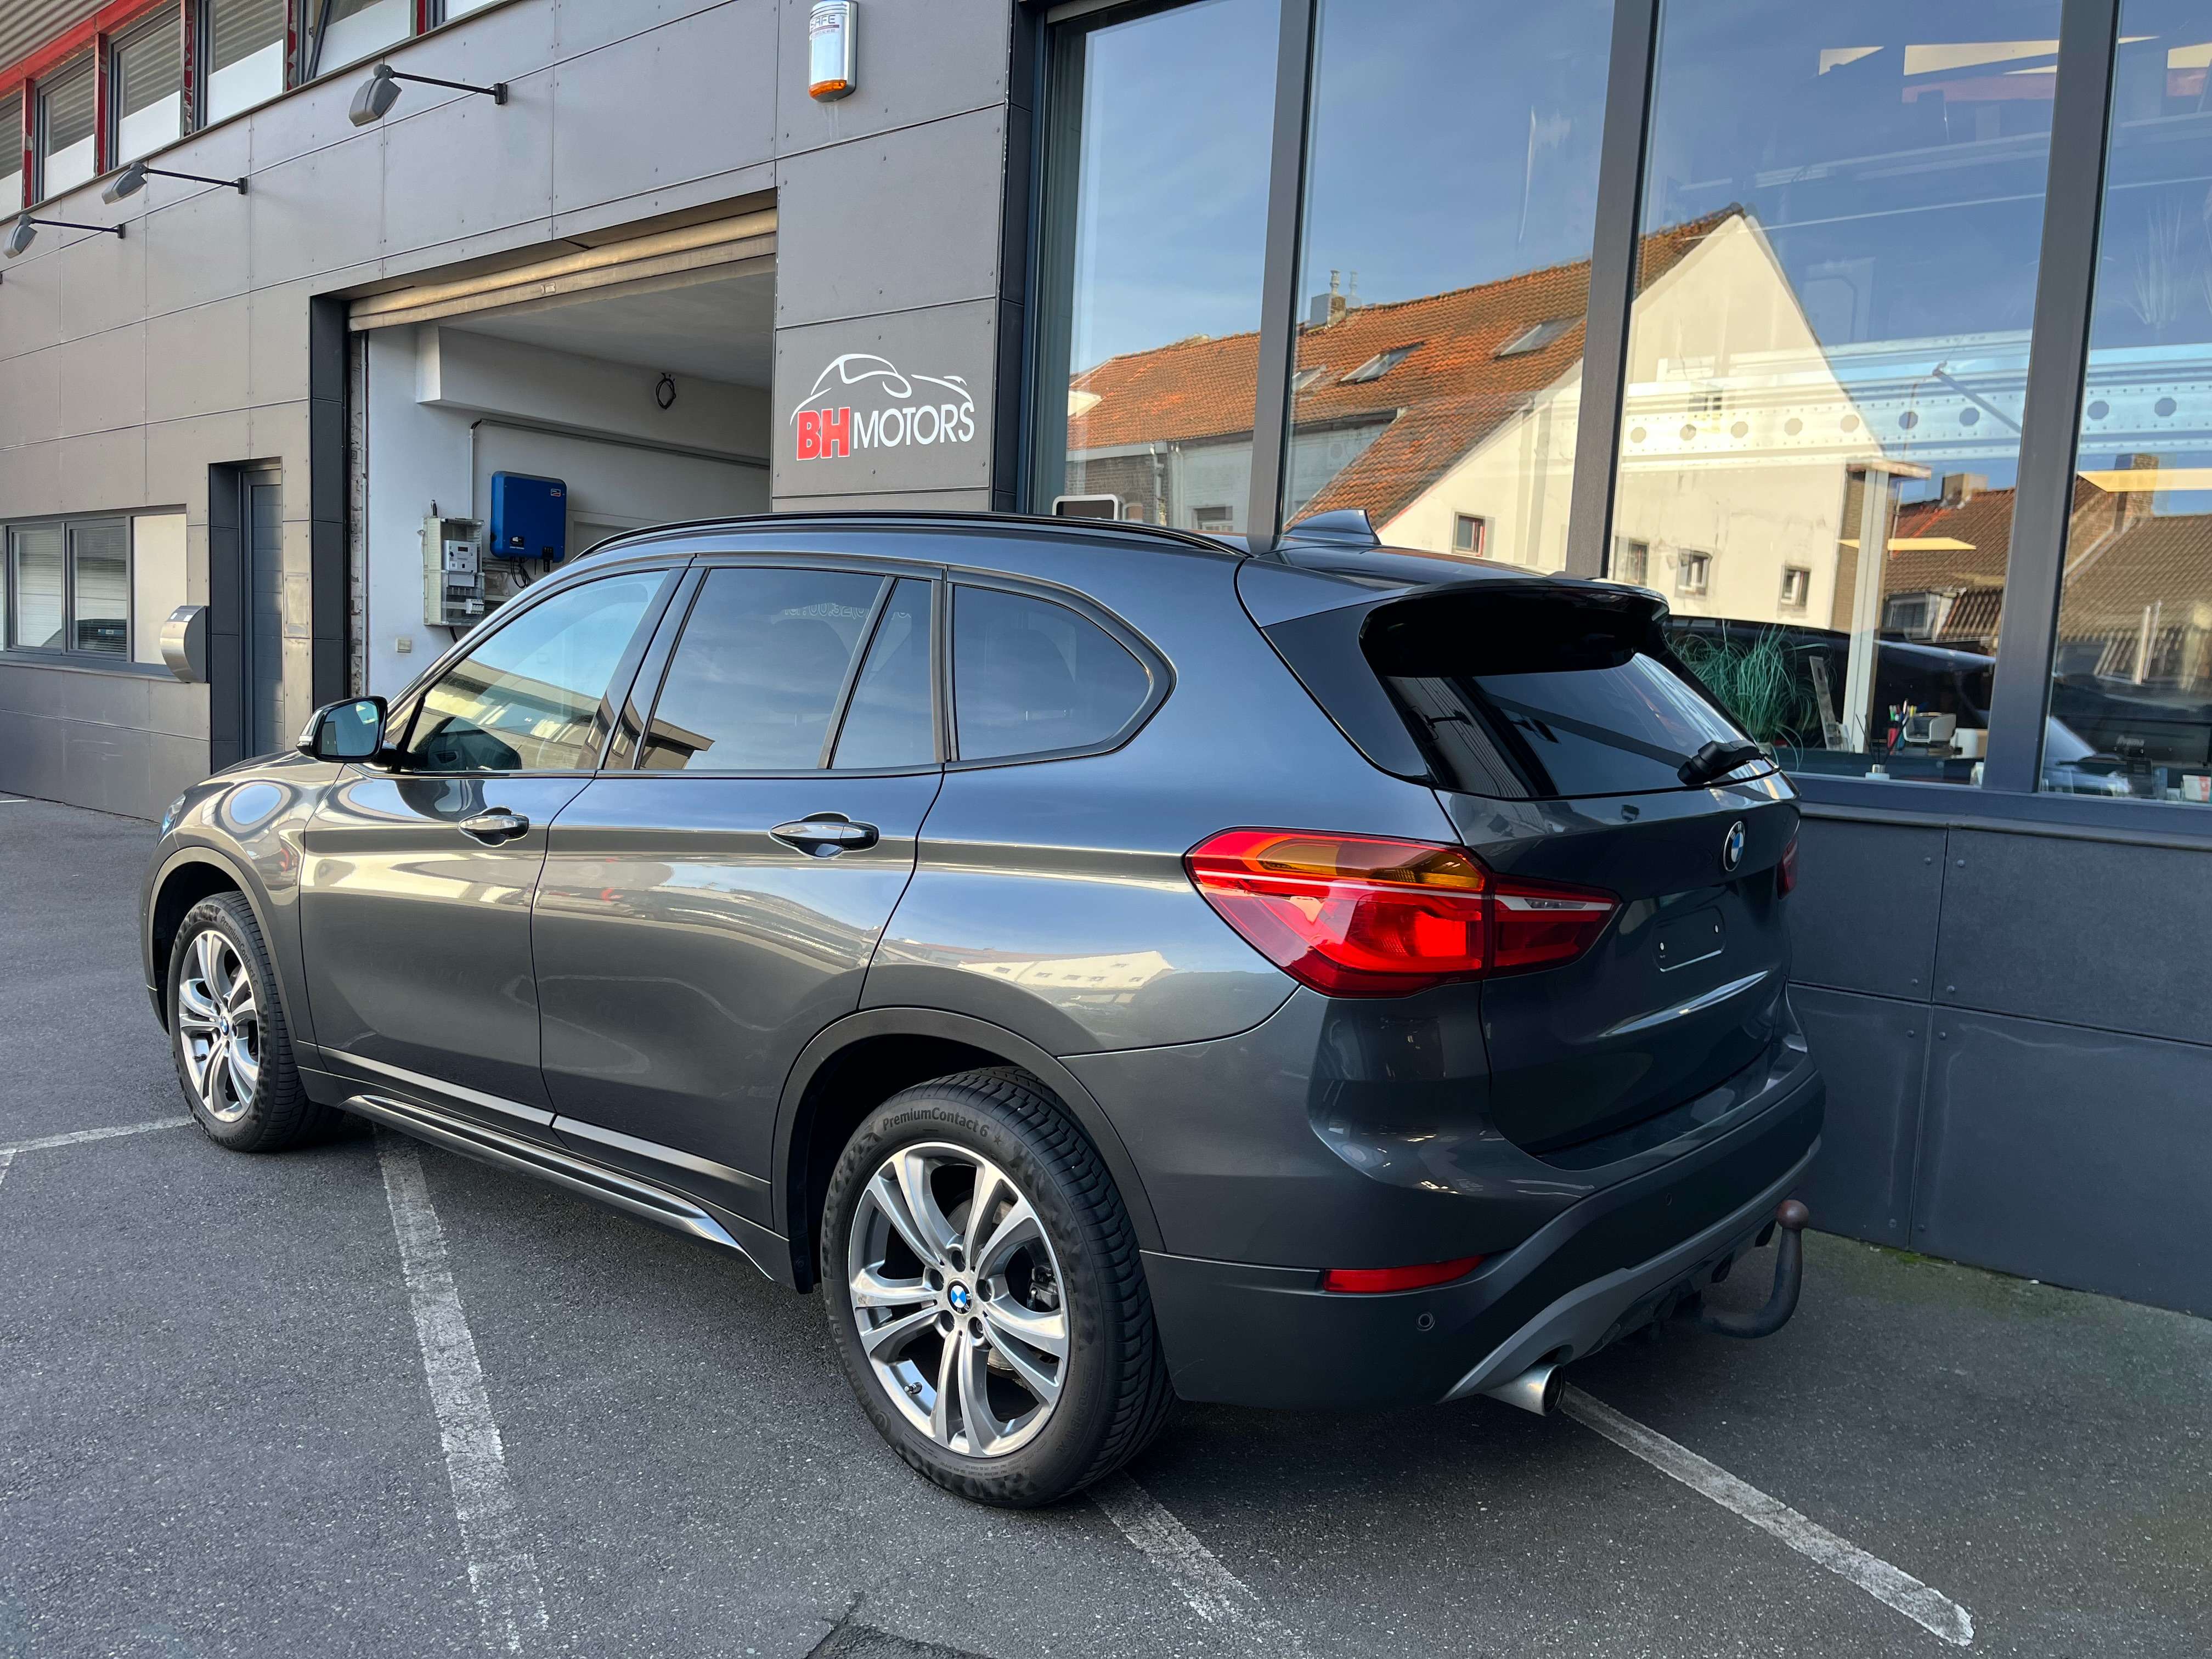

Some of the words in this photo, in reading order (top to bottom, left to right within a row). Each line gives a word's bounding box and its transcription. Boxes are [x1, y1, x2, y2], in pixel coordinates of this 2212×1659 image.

[797, 407, 850, 461] BH
[854, 402, 974, 449] MOTORS
[221, 916, 256, 978] PremiumContact
[883, 1107, 979, 1132] PremiumContact
[980, 1124, 990, 1137] 6
